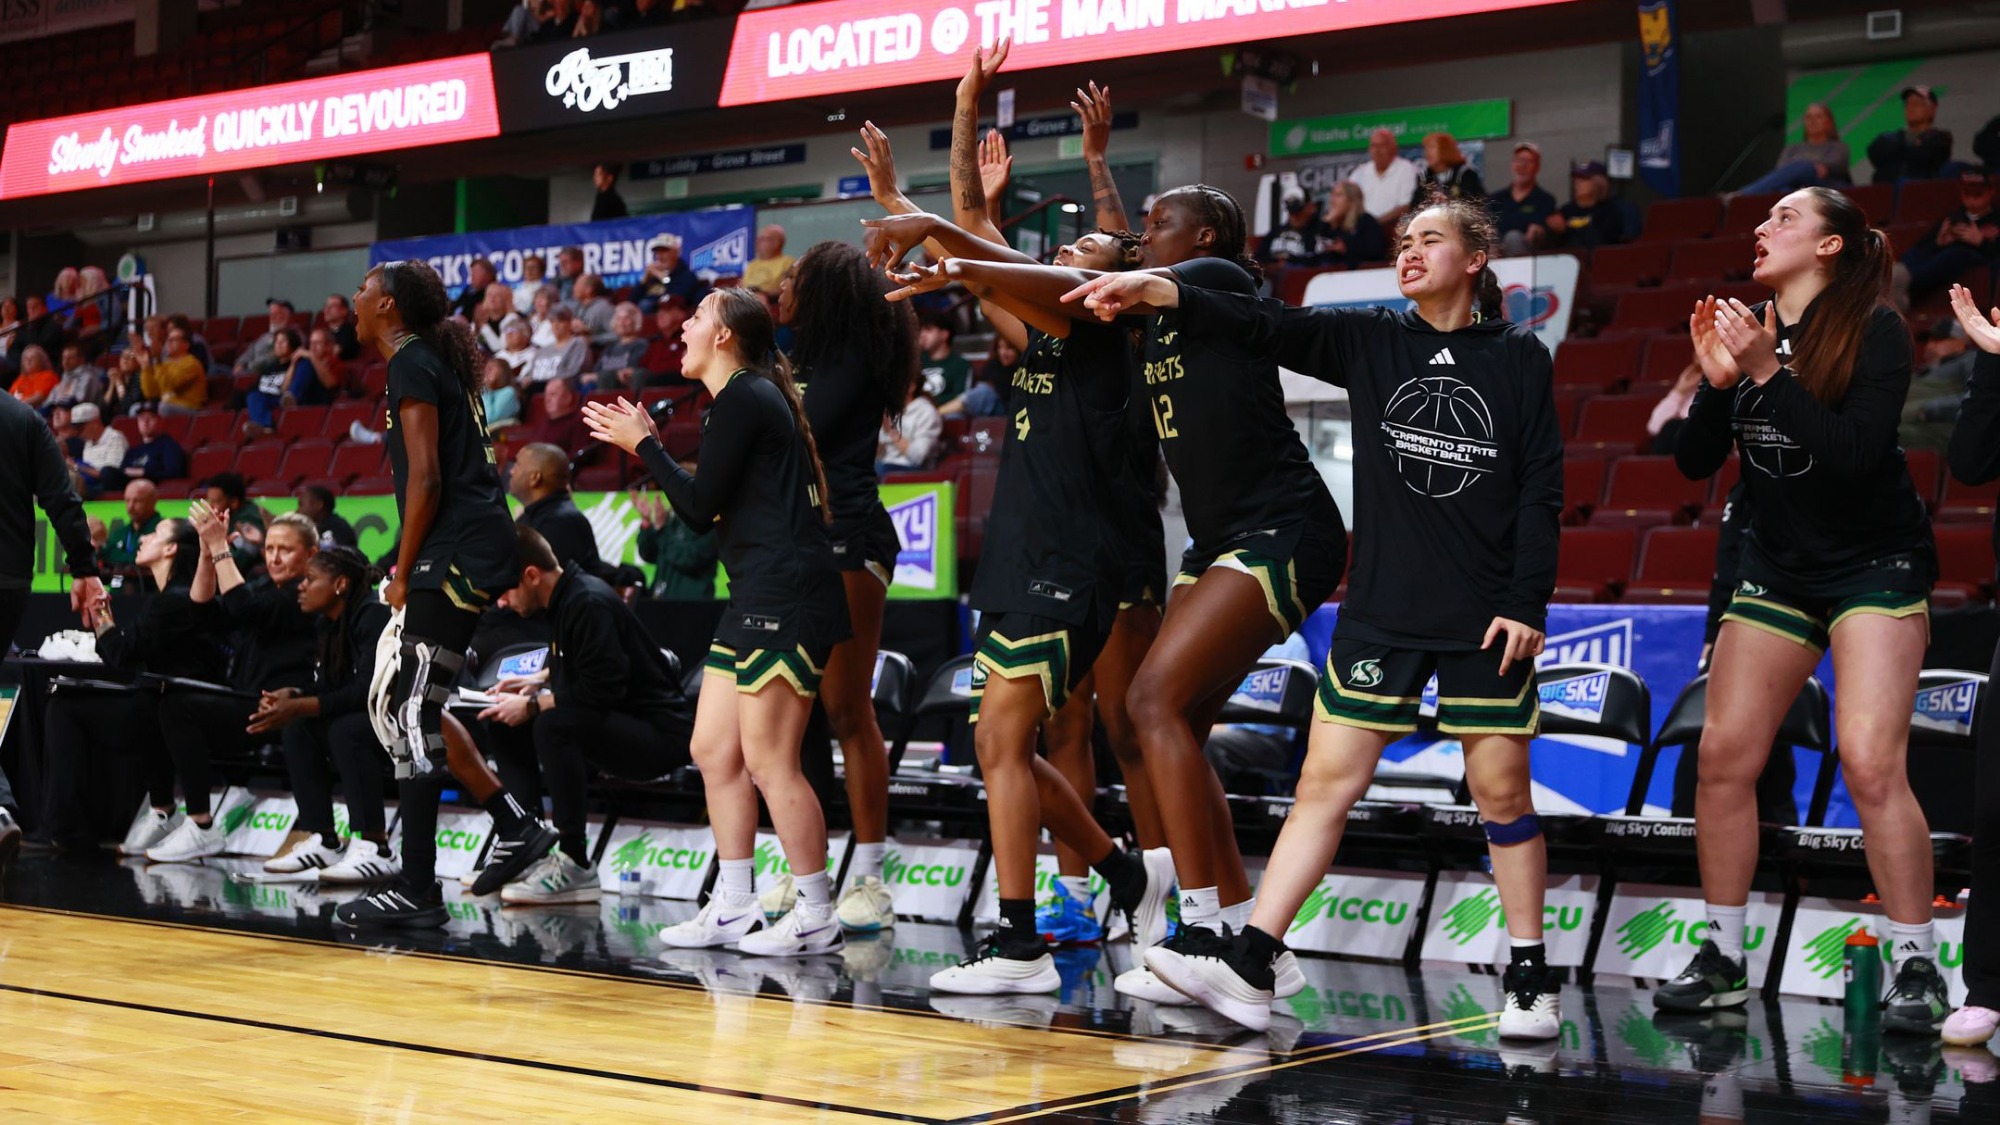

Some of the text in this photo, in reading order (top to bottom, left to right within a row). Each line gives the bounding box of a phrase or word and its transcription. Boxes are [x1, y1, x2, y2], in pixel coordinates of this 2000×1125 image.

[767, 13, 923, 78] LOCATED
[931, 7, 969, 55] @
[974, 0, 1050, 49] THE
[1060, 0, 1166, 38] MAIN
[48, 78, 466, 177] Slowly Smoked, QUICKLY DEVOURED
[1026, 119, 1067, 136] Grove
[1309, 128, 1349, 143] Idaho
[1352, 121, 1408, 140] Ceral
[665, 158, 699, 177] Lobby
[711, 152, 747, 169] Grove
[749, 148, 786, 165] Street
[1015, 406, 1031, 442] 4
[1151, 393, 1179, 440] 12
[1380, 421, 1499, 458] SACRAMENTO STATE
[1742, 432, 1795, 444] BASKETB
[1394, 439, 1474, 463] BASKETBALL
[1540, 675, 1605, 702] BIGSKY
[1916, 684, 1974, 713] GSKY
[888, 783, 929, 796] nference
[1268, 803, 1285, 818] Big
[1434, 810, 1450, 824] Big
[1453, 811, 1476, 826] Sky
[437, 828, 481, 853] CCU
[1605, 822, 1697, 838] Big Sky Confer
[1798, 833, 1820, 849] Big
[1822, 835, 1849, 851] Sky
[646, 846, 707, 871] ICCU
[893, 859, 965, 888] ICCU
[1326, 895, 1409, 926] ICCU
